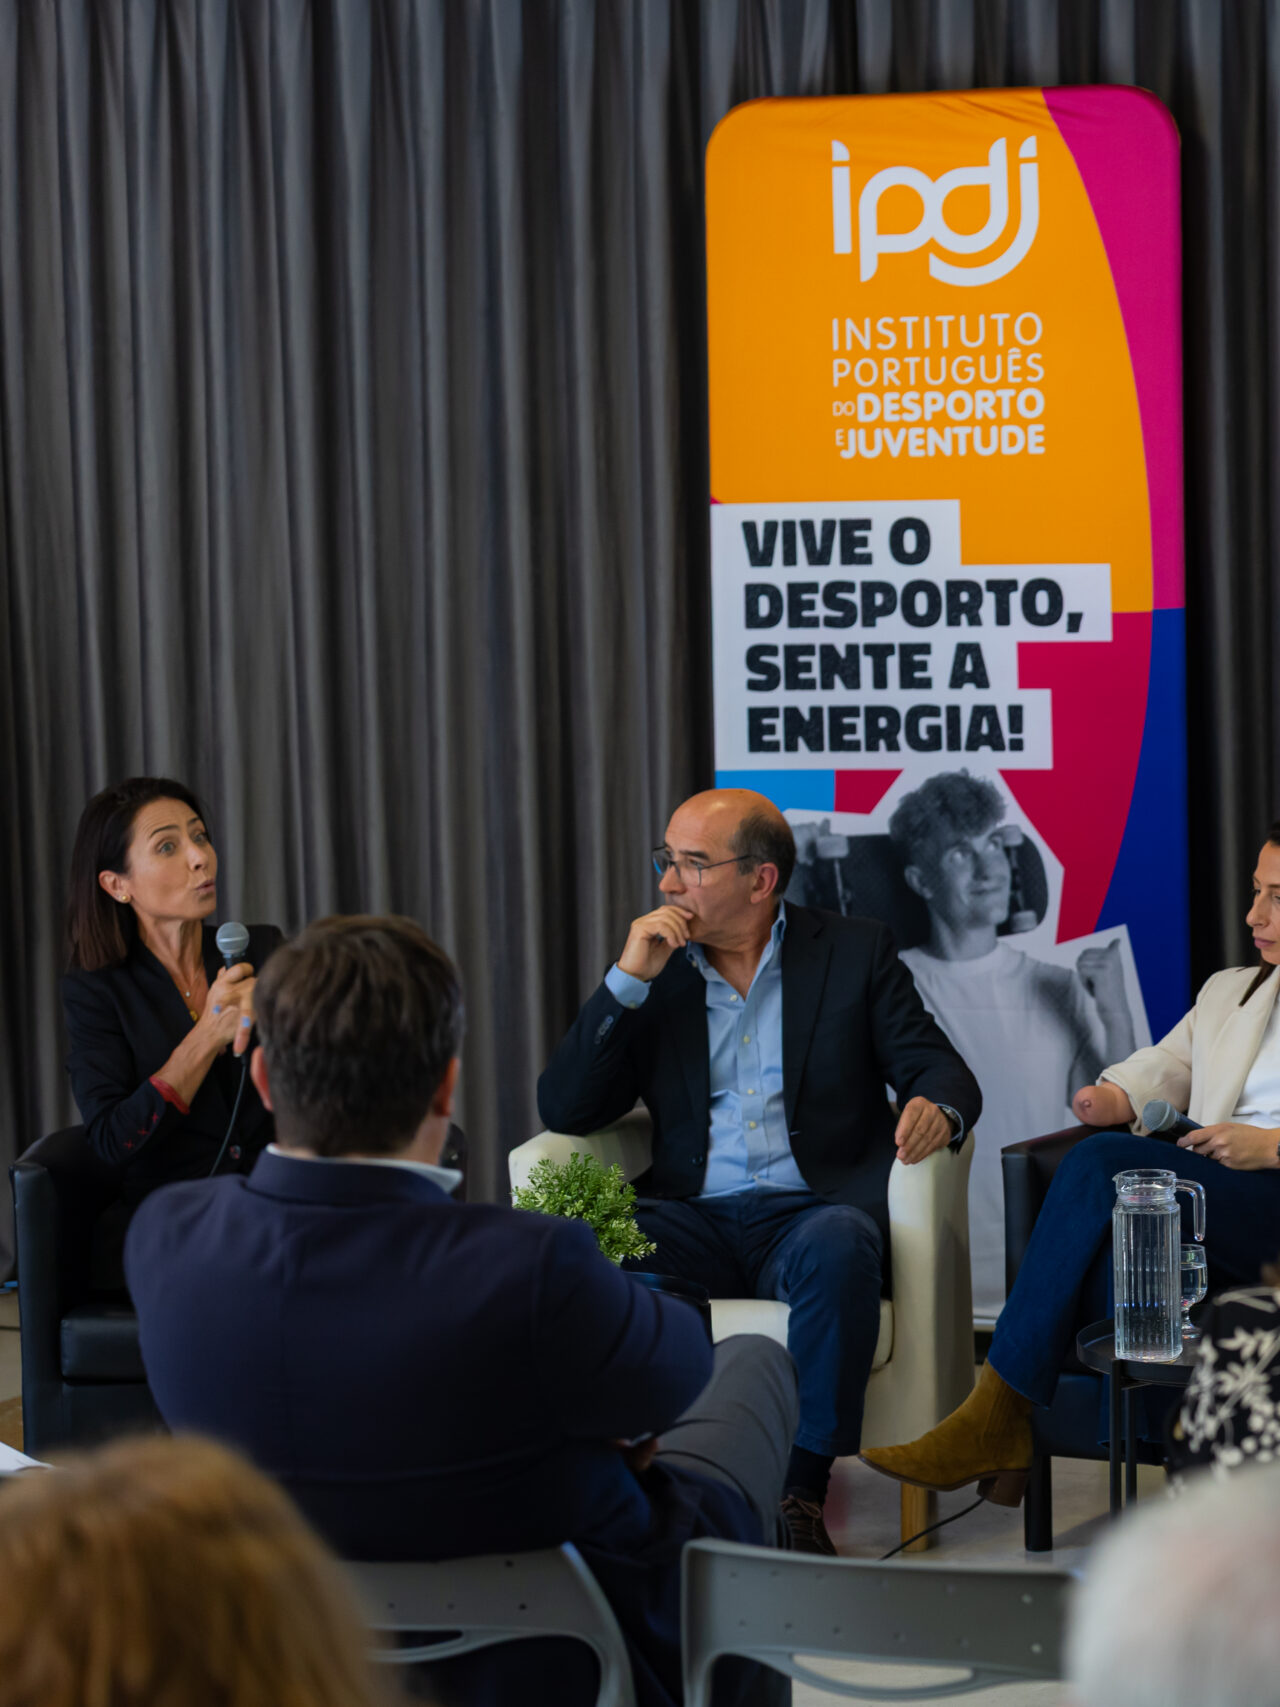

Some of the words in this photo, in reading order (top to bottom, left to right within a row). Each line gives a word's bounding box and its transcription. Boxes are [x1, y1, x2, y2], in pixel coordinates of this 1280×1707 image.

[832, 136, 1039, 287] ipdj
[832, 312, 1043, 351] INSTITUTO
[833, 347, 1044, 387] PORTUGUÊS
[832, 401, 856, 416] DO
[857, 388, 1045, 422] DESPORTO
[835, 429, 844, 446] E
[840, 424, 1045, 459] JUVENTUDE
[742, 518, 873, 567] VIVE
[889, 517, 931, 566] O
[744, 578, 1083, 633] DESPORTO,
[745, 643, 932, 692] SENTE
[948, 642, 990, 689] A
[747, 704, 1024, 753] ENERGIA!
